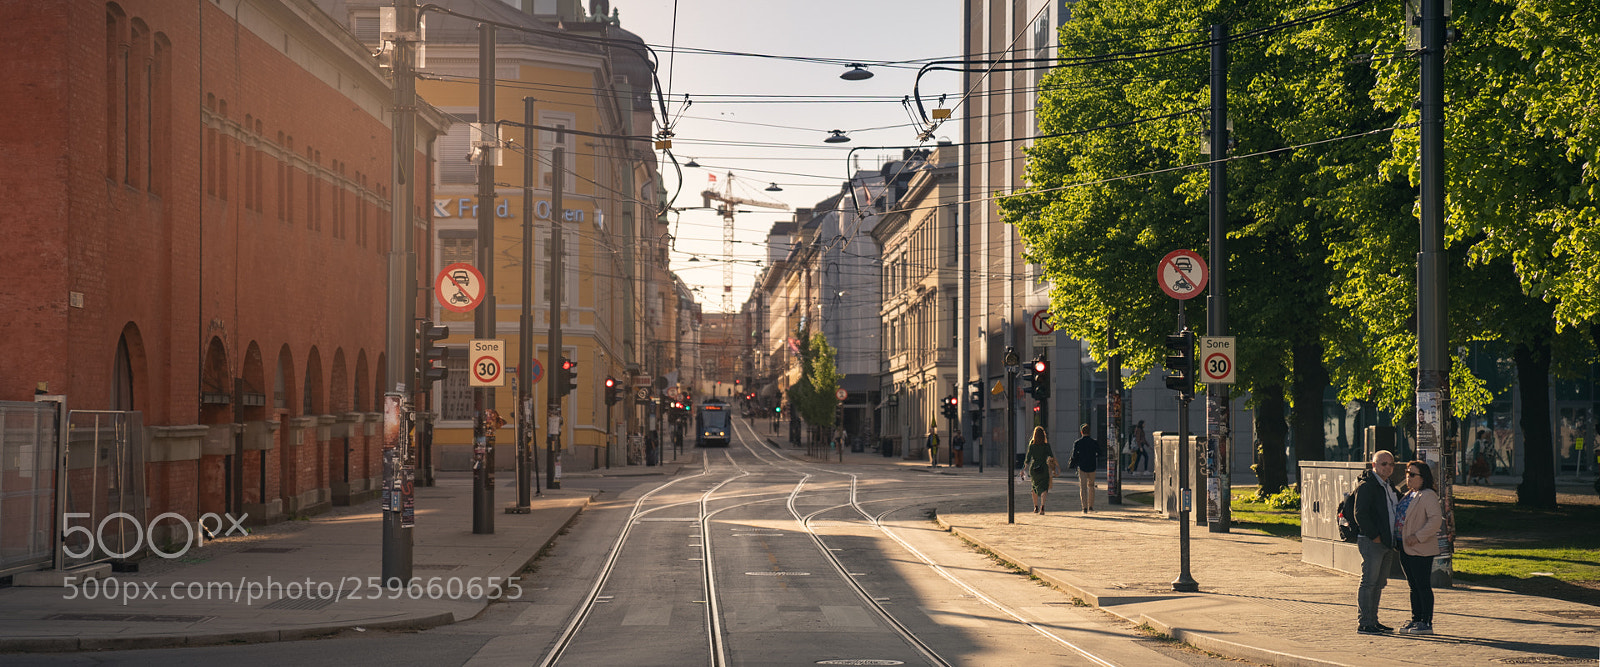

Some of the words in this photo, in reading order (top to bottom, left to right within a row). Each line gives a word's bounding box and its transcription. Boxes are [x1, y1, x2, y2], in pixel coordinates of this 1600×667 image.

[458, 198, 514, 218] Frd.
[475, 342, 499, 351] Sone
[1206, 339, 1230, 349] Sone
[478, 363, 496, 376] 30
[1209, 359, 1227, 373] 30
